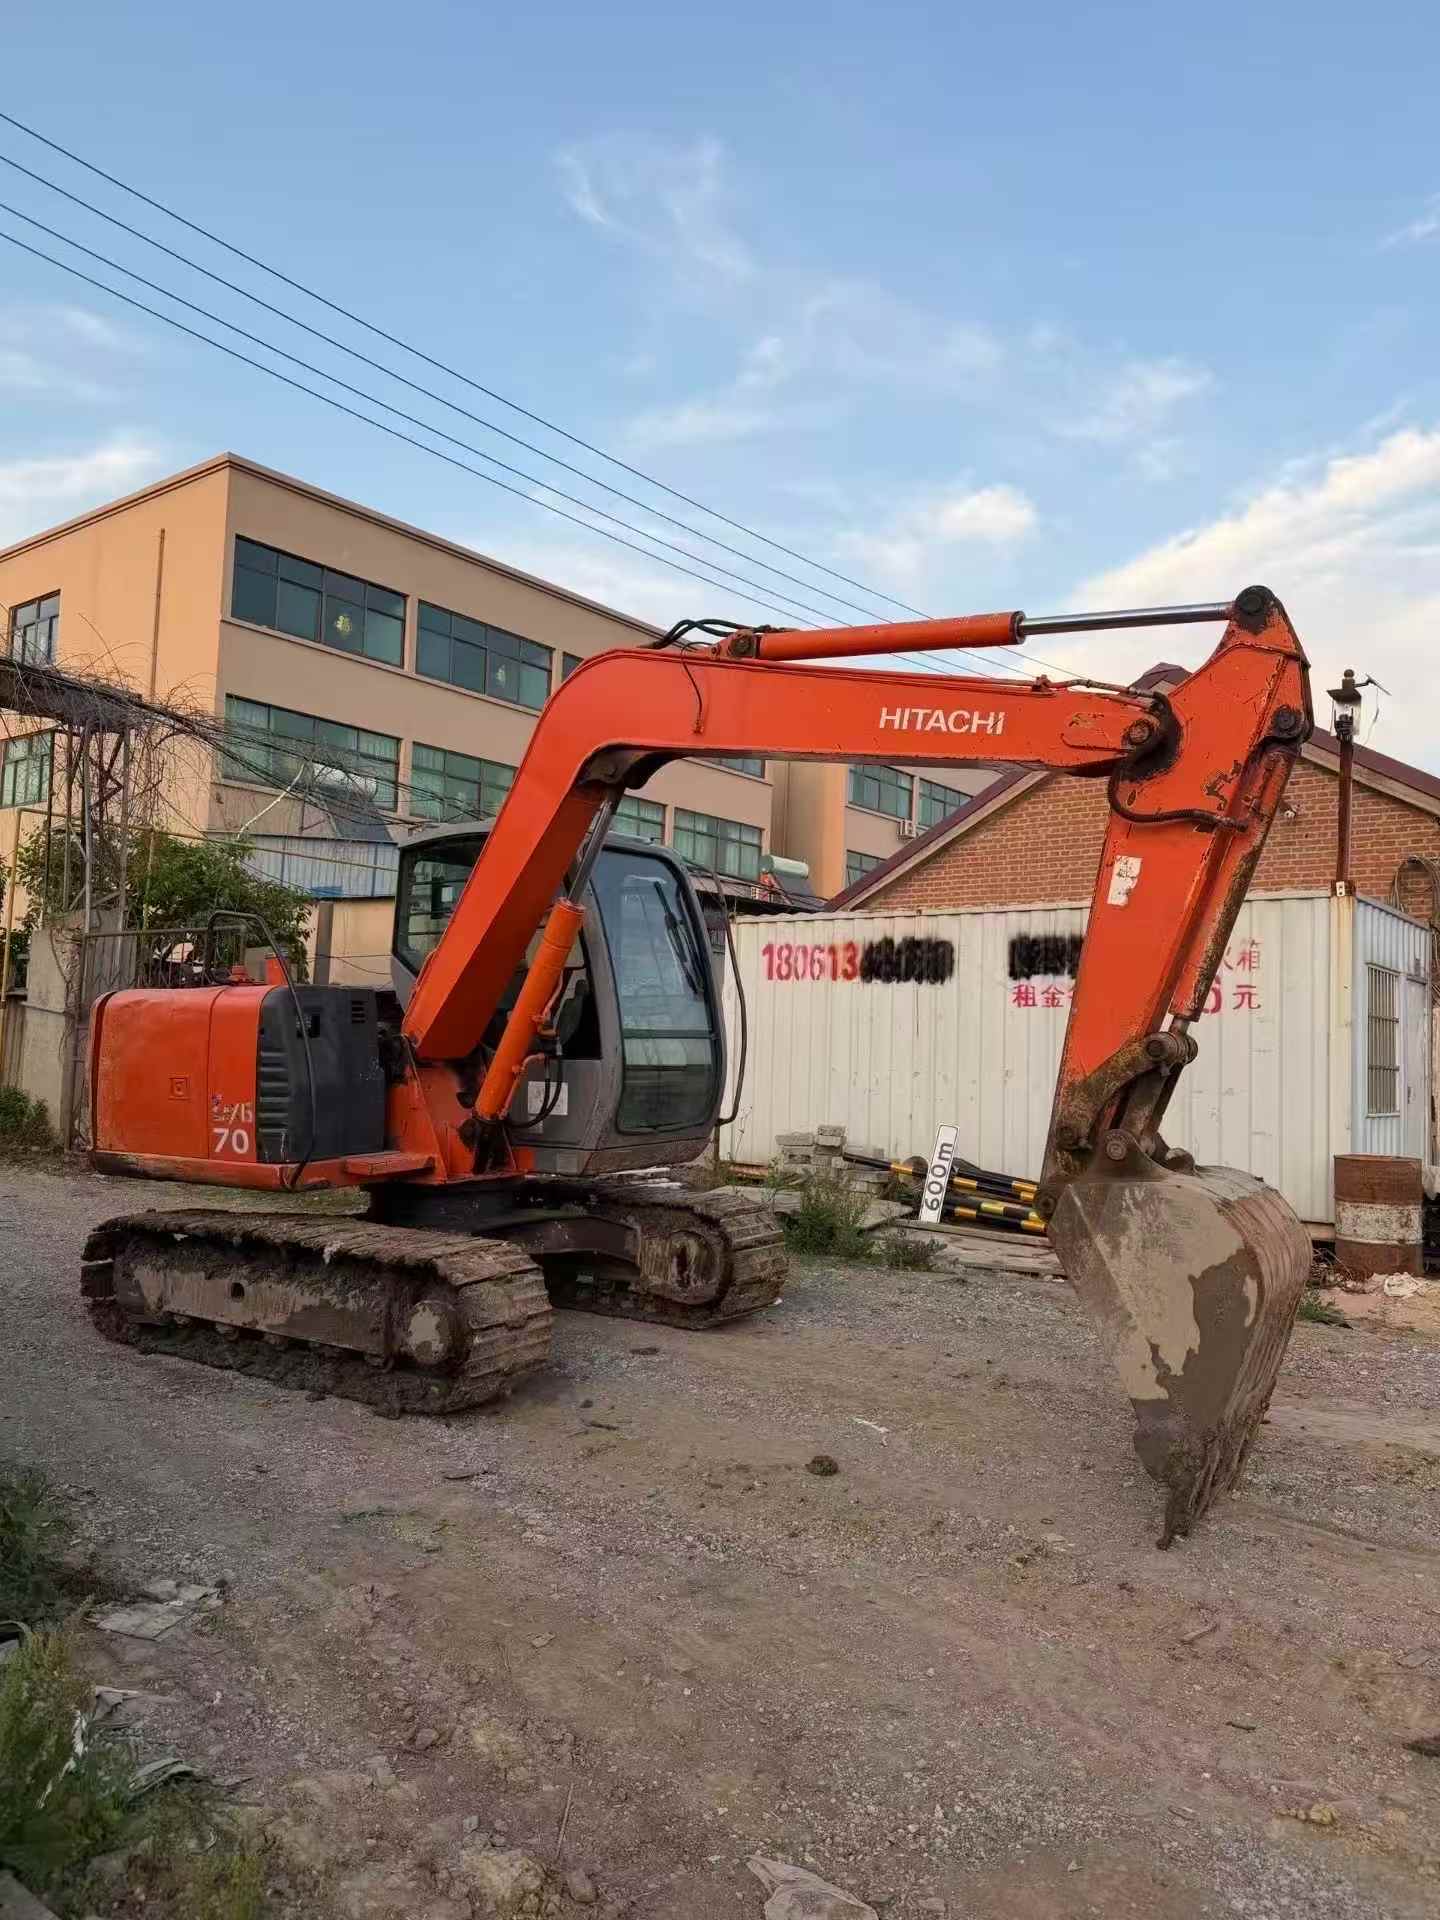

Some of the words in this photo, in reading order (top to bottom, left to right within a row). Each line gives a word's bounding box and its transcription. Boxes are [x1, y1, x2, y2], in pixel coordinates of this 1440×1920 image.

[879, 707, 1006, 735] HITACHI
[1012, 984, 1074, 1008] 租金
[213, 1127, 249, 1155] 70
[924, 1142, 954, 1211] 600m
